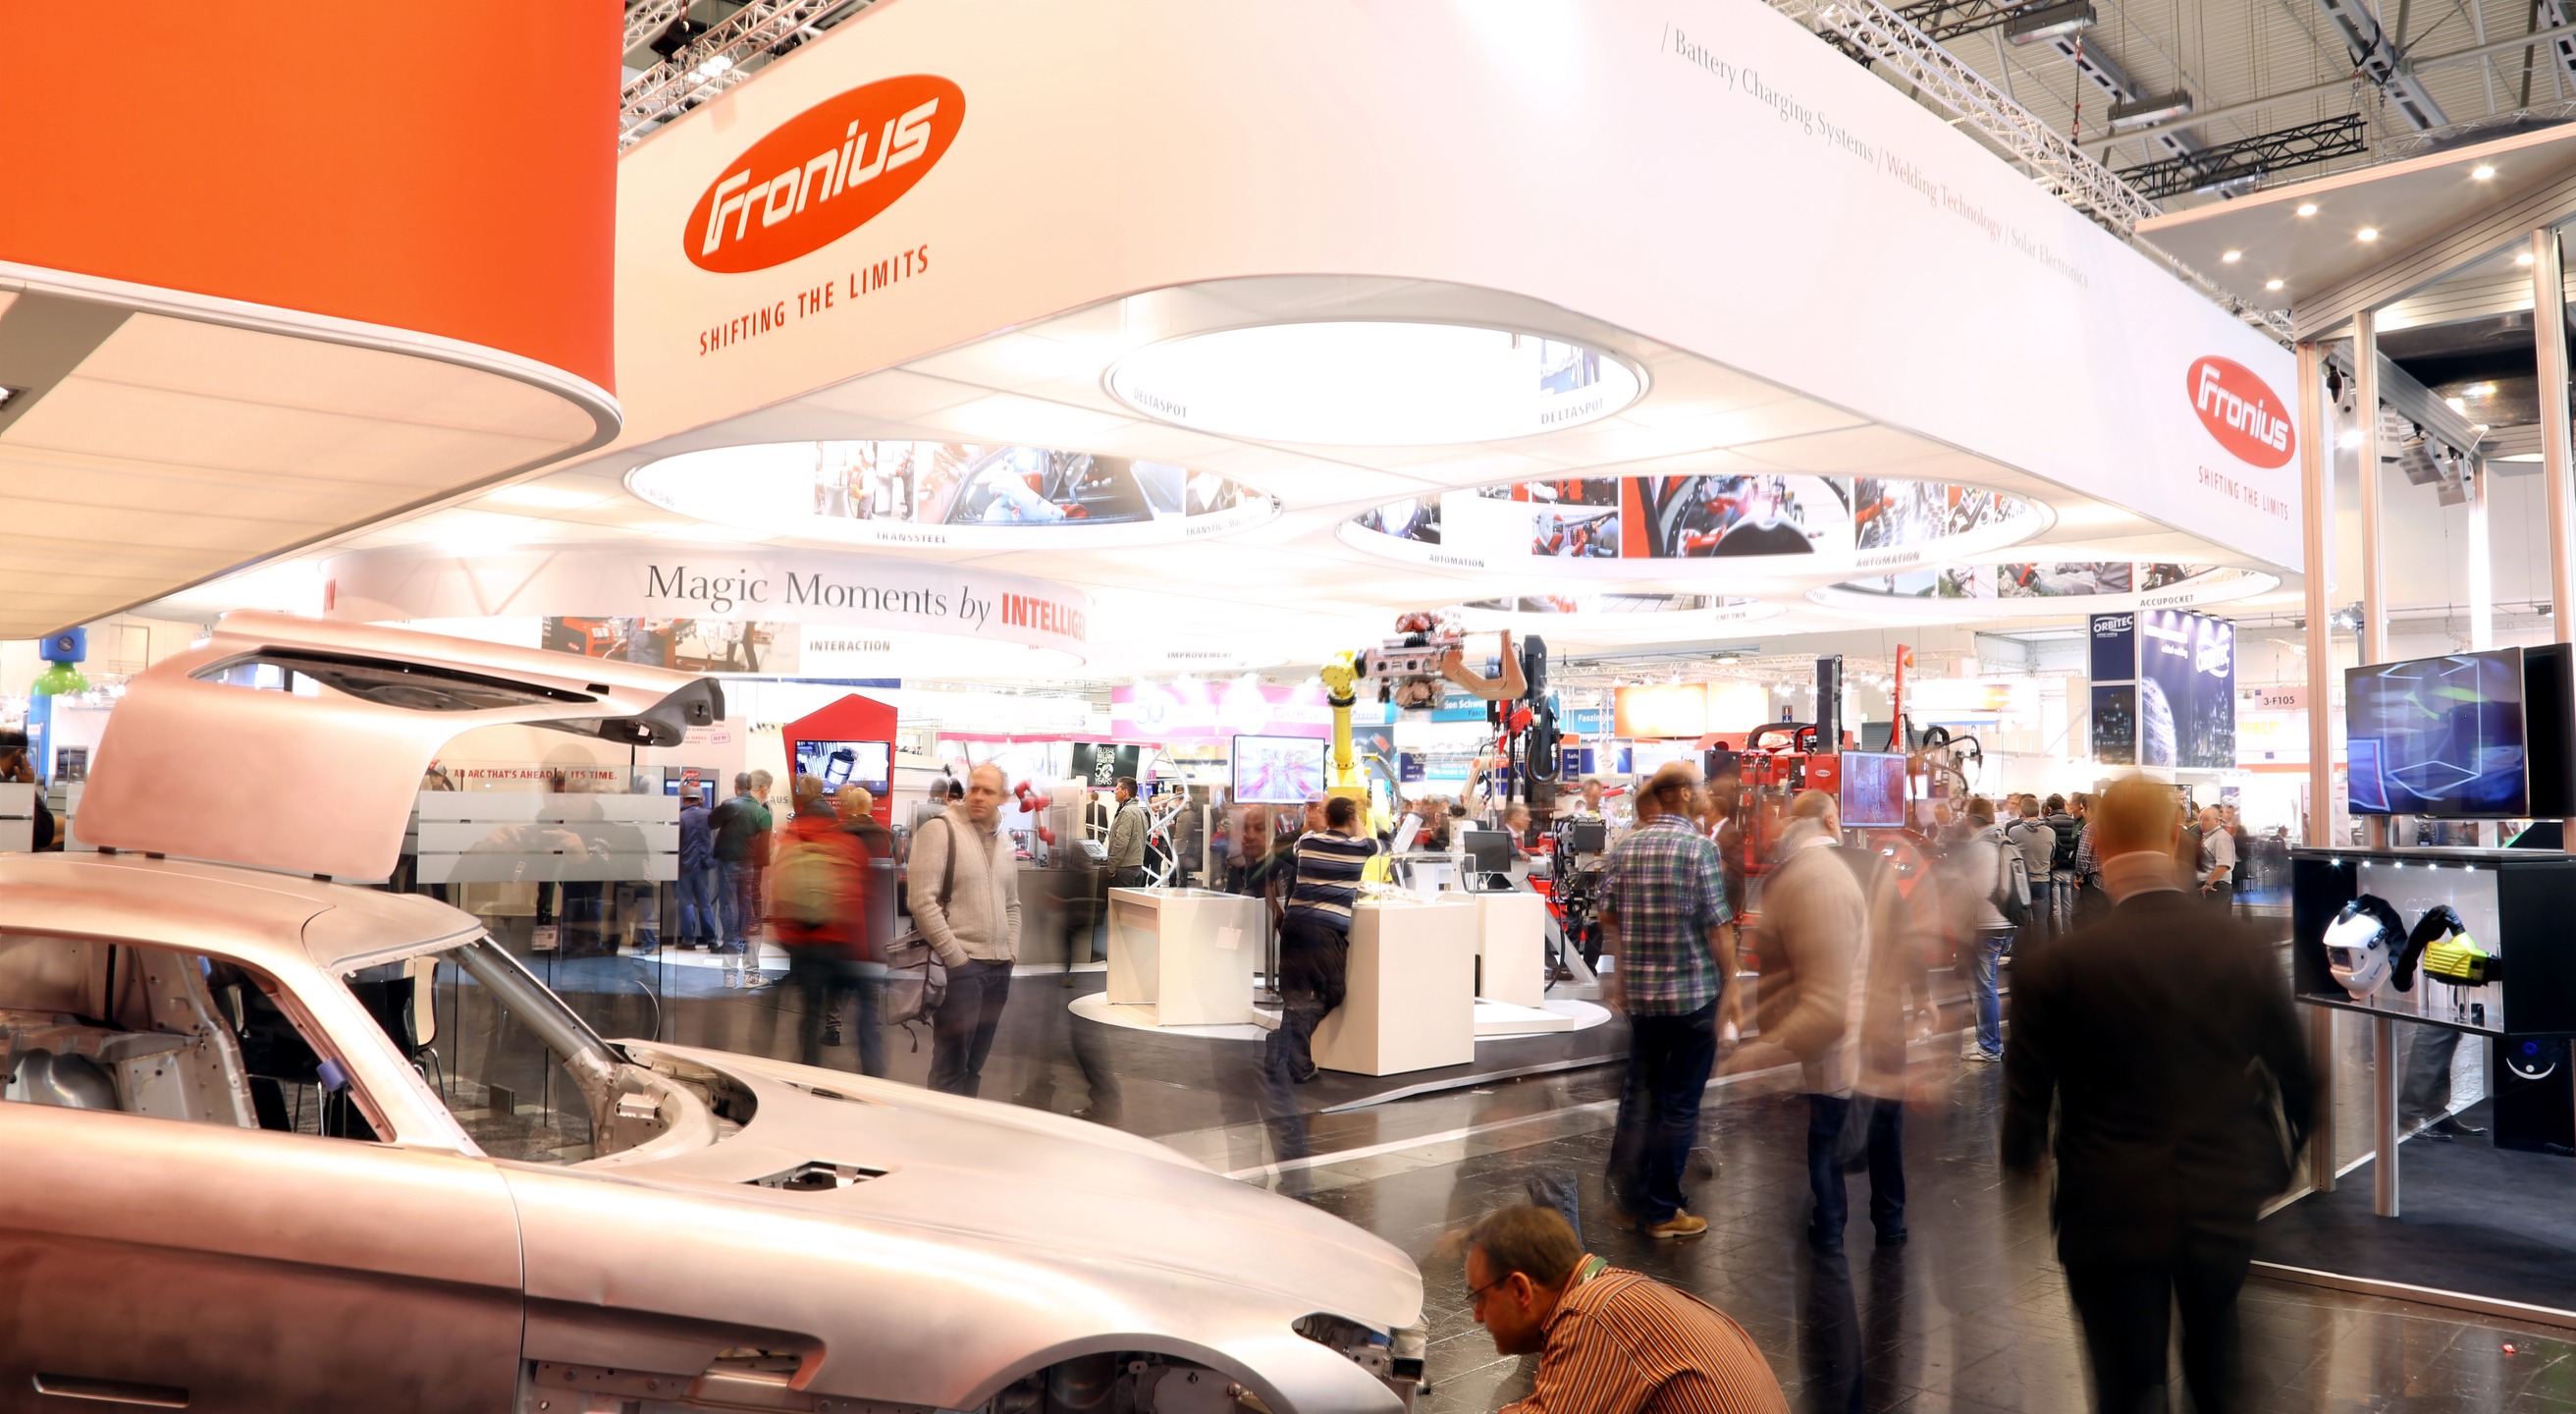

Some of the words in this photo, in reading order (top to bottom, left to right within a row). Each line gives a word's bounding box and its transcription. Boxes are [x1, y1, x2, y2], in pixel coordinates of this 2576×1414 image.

[1676, 28, 1737, 91] Battery
[1742, 68, 1813, 136] Charging
[1817, 110, 1874, 164] Systems
[1886, 150, 1938, 208] Welding
[1940, 184, 2003, 244] Technology
[2012, 227, 2037, 259] Solar
[2039, 243, 2089, 290] Electronics
[701, 96, 939, 256] Fronius
[699, 299, 785, 356] SHIFTING
[797, 280, 834, 320] THE
[849, 243, 929, 299] LIMITS
[1134, 387, 1188, 418] DELTASPOT
[1540, 397, 1604, 425] DELTASPOT
[2196, 362, 2289, 454] Fronius
[2198, 464, 2239, 500] SHIFTING
[2243, 485, 2259, 509] THE
[2262, 494, 2289, 521] LIMITS
[876, 530, 948, 544] TRANSSTEEL
[1428, 553, 1485, 569] AUTOMATION
[1855, 550, 1921, 569] AUTOMATION
[644, 565, 770, 615] Magic
[784, 571, 948, 617] Moments
[958, 585, 992, 631] by
[2139, 594, 2195, 608] ACCUPOCKET
[1731, 611, 1747, 622] TWIN
[2093, 615, 2134, 634] ORBITEC
[809, 639, 891, 653] INTERACTION
[2263, 695, 2296, 707] 3-F105
[468, 769, 485, 779] ARC
[487, 770, 517, 780] THAT'S
[519, 770, 553, 780] AHEAD
[570, 770, 586, 780] ITS
[589, 770, 617, 781] TIME.
[1094, 776, 1113, 786] YEARS
